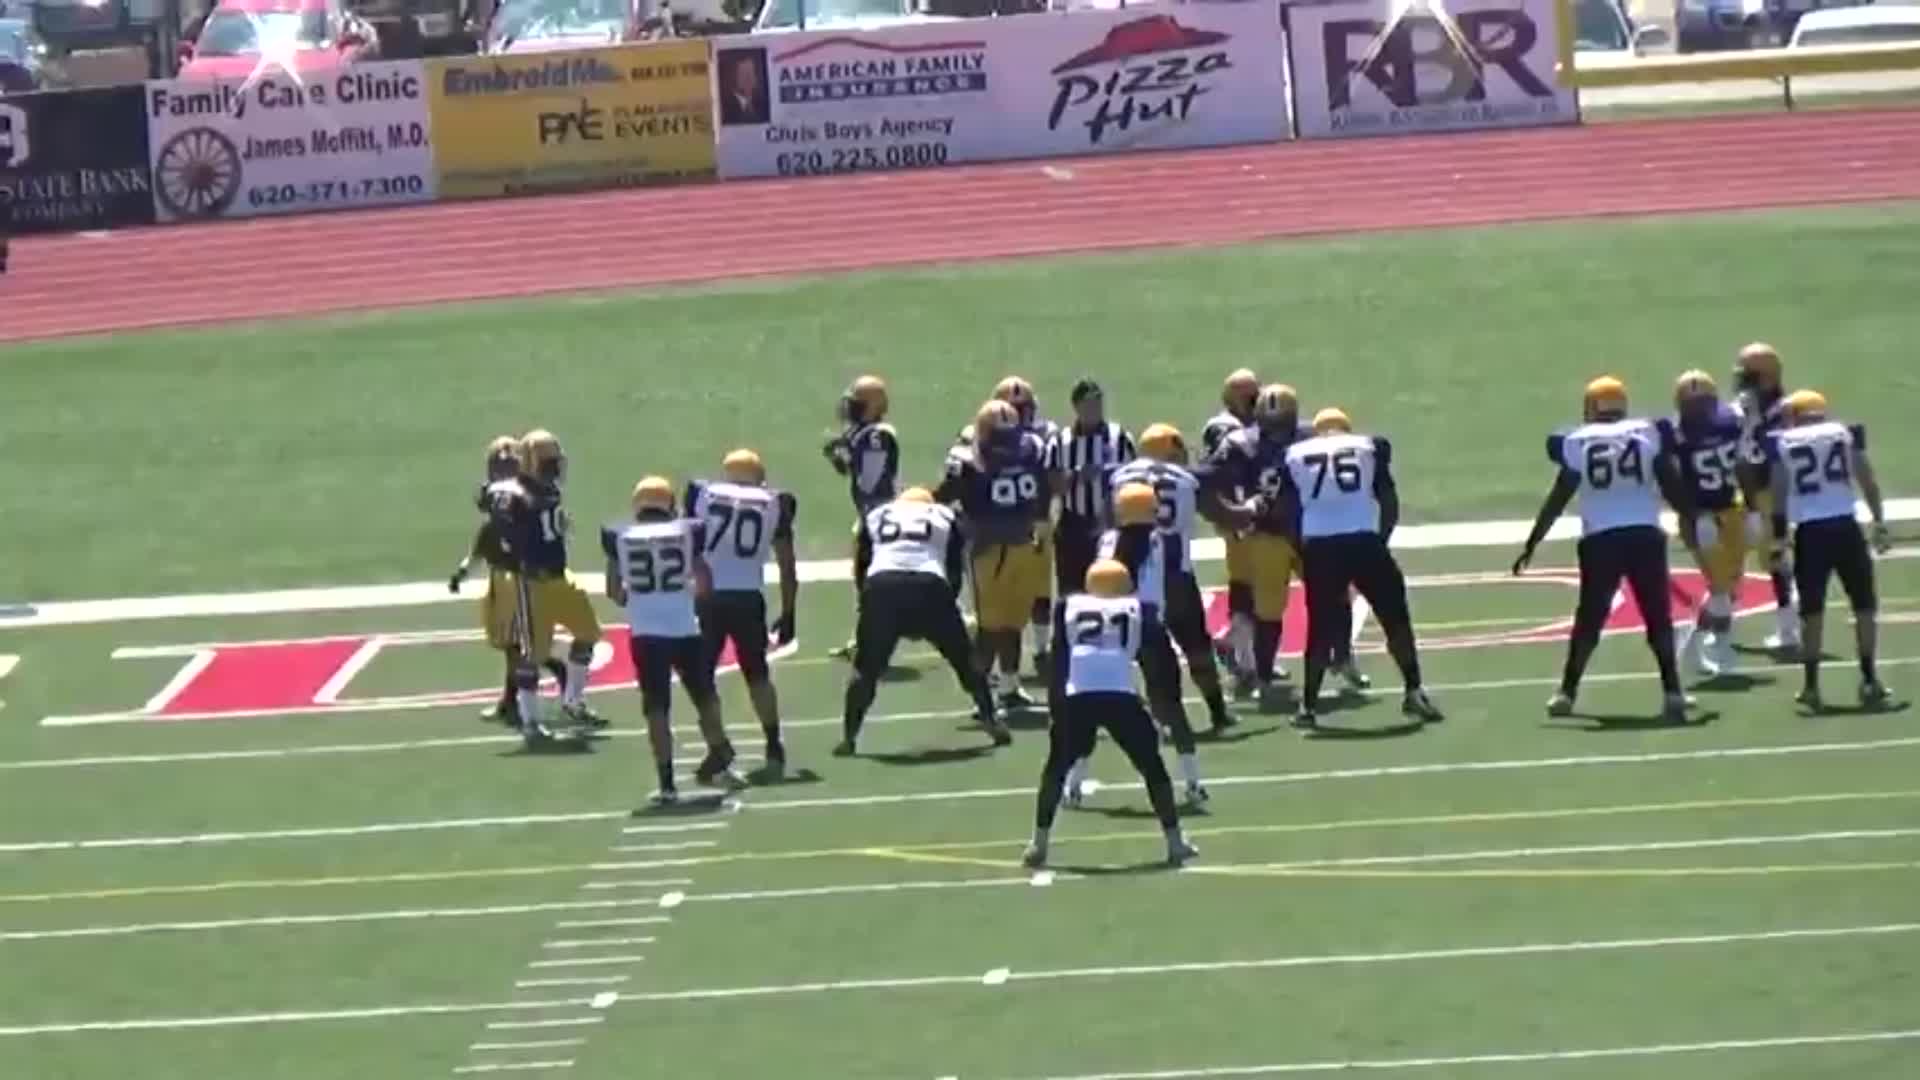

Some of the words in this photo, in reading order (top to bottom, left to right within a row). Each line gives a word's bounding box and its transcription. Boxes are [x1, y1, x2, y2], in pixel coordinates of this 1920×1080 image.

[780, 60, 896, 82] AMERICAN
[904, 53, 984, 75] FAMILY
[152, 84, 248, 119] Family
[257, 79, 326, 108] Care
[337, 71, 420, 104] Clinic
[1048, 52, 1233, 131] Pizza
[1084, 83, 1212, 143] Hut
[242, 134, 306, 161] James
[616, 113, 707, 138] EVENTS
[765, 122, 817, 144] Chris
[880, 116, 954, 138] Agency
[80, 167, 150, 196] BANK
[776, 142, 947, 177] 620.225.0800
[1303, 447, 1361, 500] 76
[1585, 437, 1644, 489] 64
[1789, 441, 1849, 495] 24
[707, 502, 764, 558] 70
[628, 547, 686, 594] 32
[1073, 610, 1131, 650] 21
